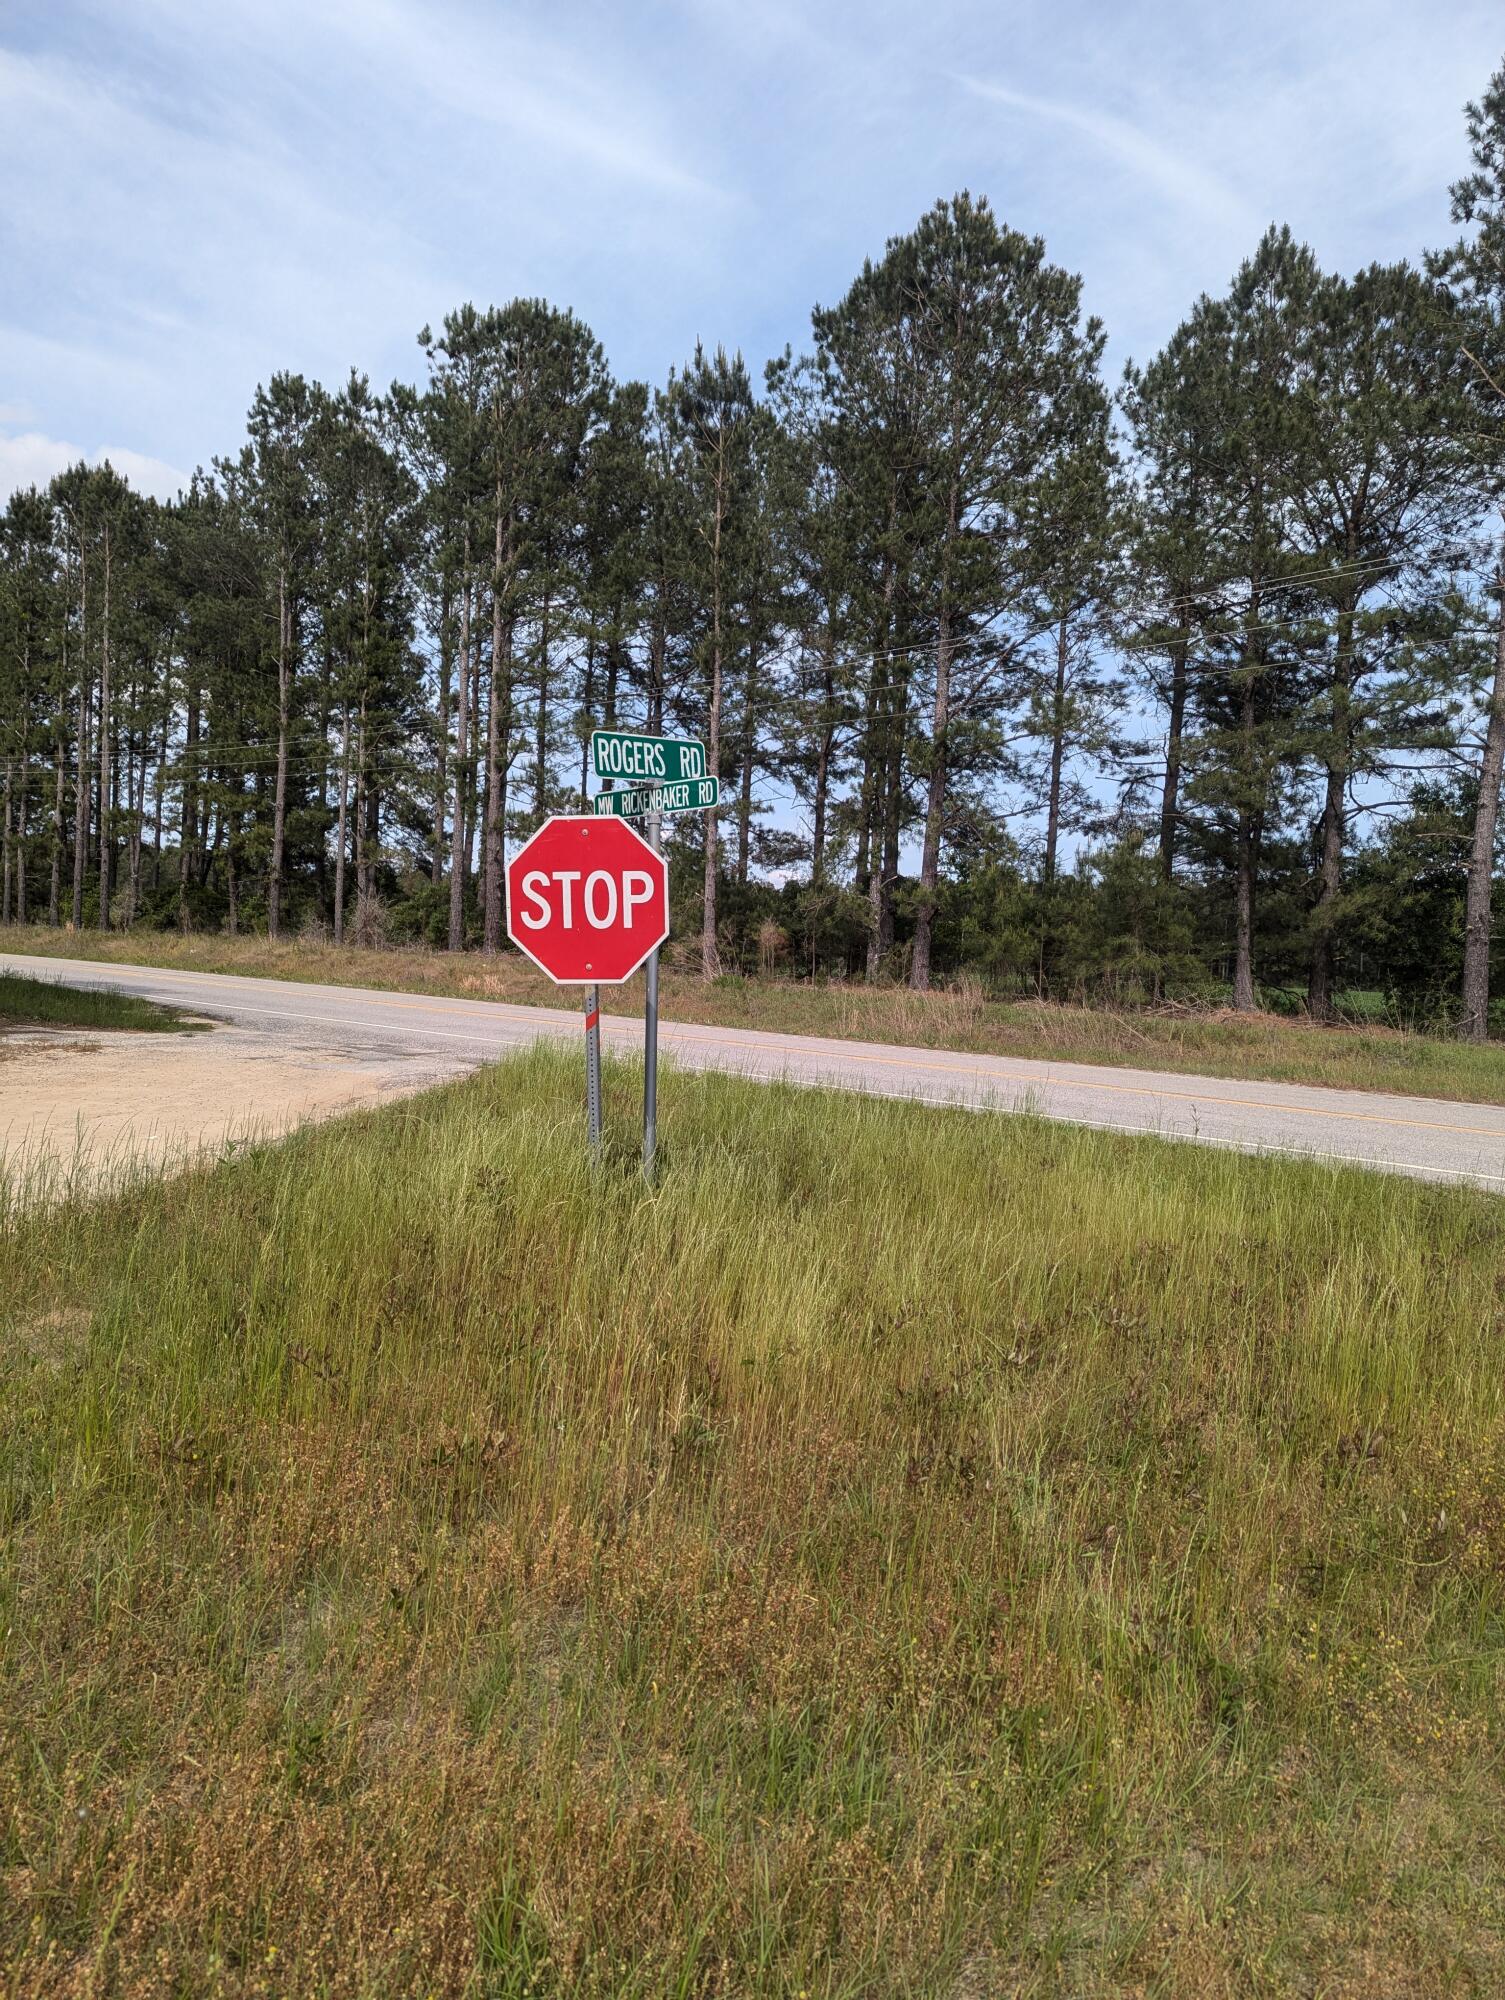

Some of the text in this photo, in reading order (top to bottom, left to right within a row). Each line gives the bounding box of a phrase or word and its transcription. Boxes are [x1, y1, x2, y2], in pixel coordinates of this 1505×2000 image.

[598, 738, 701, 778] ROGERS RD
[597, 781, 713, 815] MW RICKENBAKER RD
[520, 870, 654, 930] STOP
